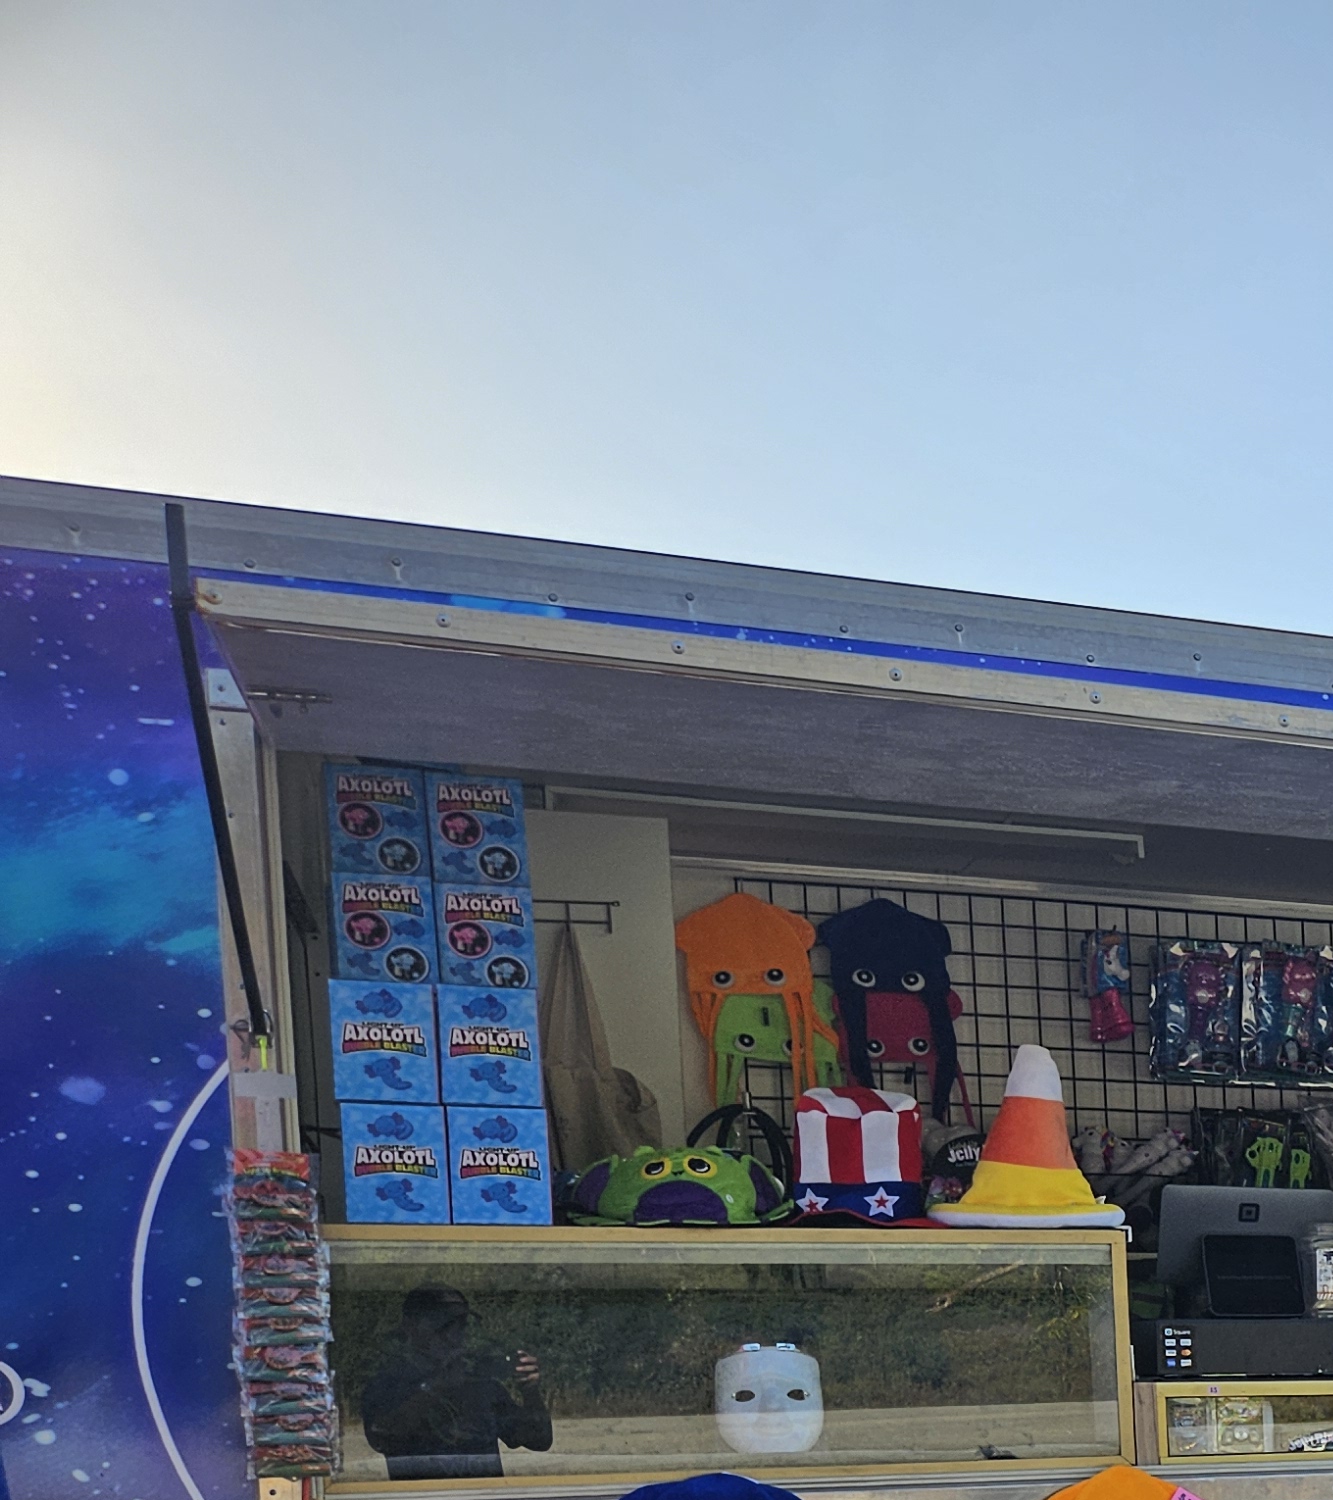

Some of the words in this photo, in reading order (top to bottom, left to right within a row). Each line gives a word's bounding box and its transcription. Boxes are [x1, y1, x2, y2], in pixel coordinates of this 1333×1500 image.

[338, 776, 412, 797] AXOLOTL
[439, 785, 510, 805] AXOLOTL
[344, 884, 420, 904] AXOLOTL
[446, 894, 521, 914] AXOLOTL
[344, 1024, 423, 1044] AXOLOTL
[451, 1029, 529, 1048] AXOLOTL
[356, 1148, 435, 1166] AXOLOTL
[462, 1151, 538, 1168] AXOLOTL
[947, 1144, 980, 1163] Jelly
